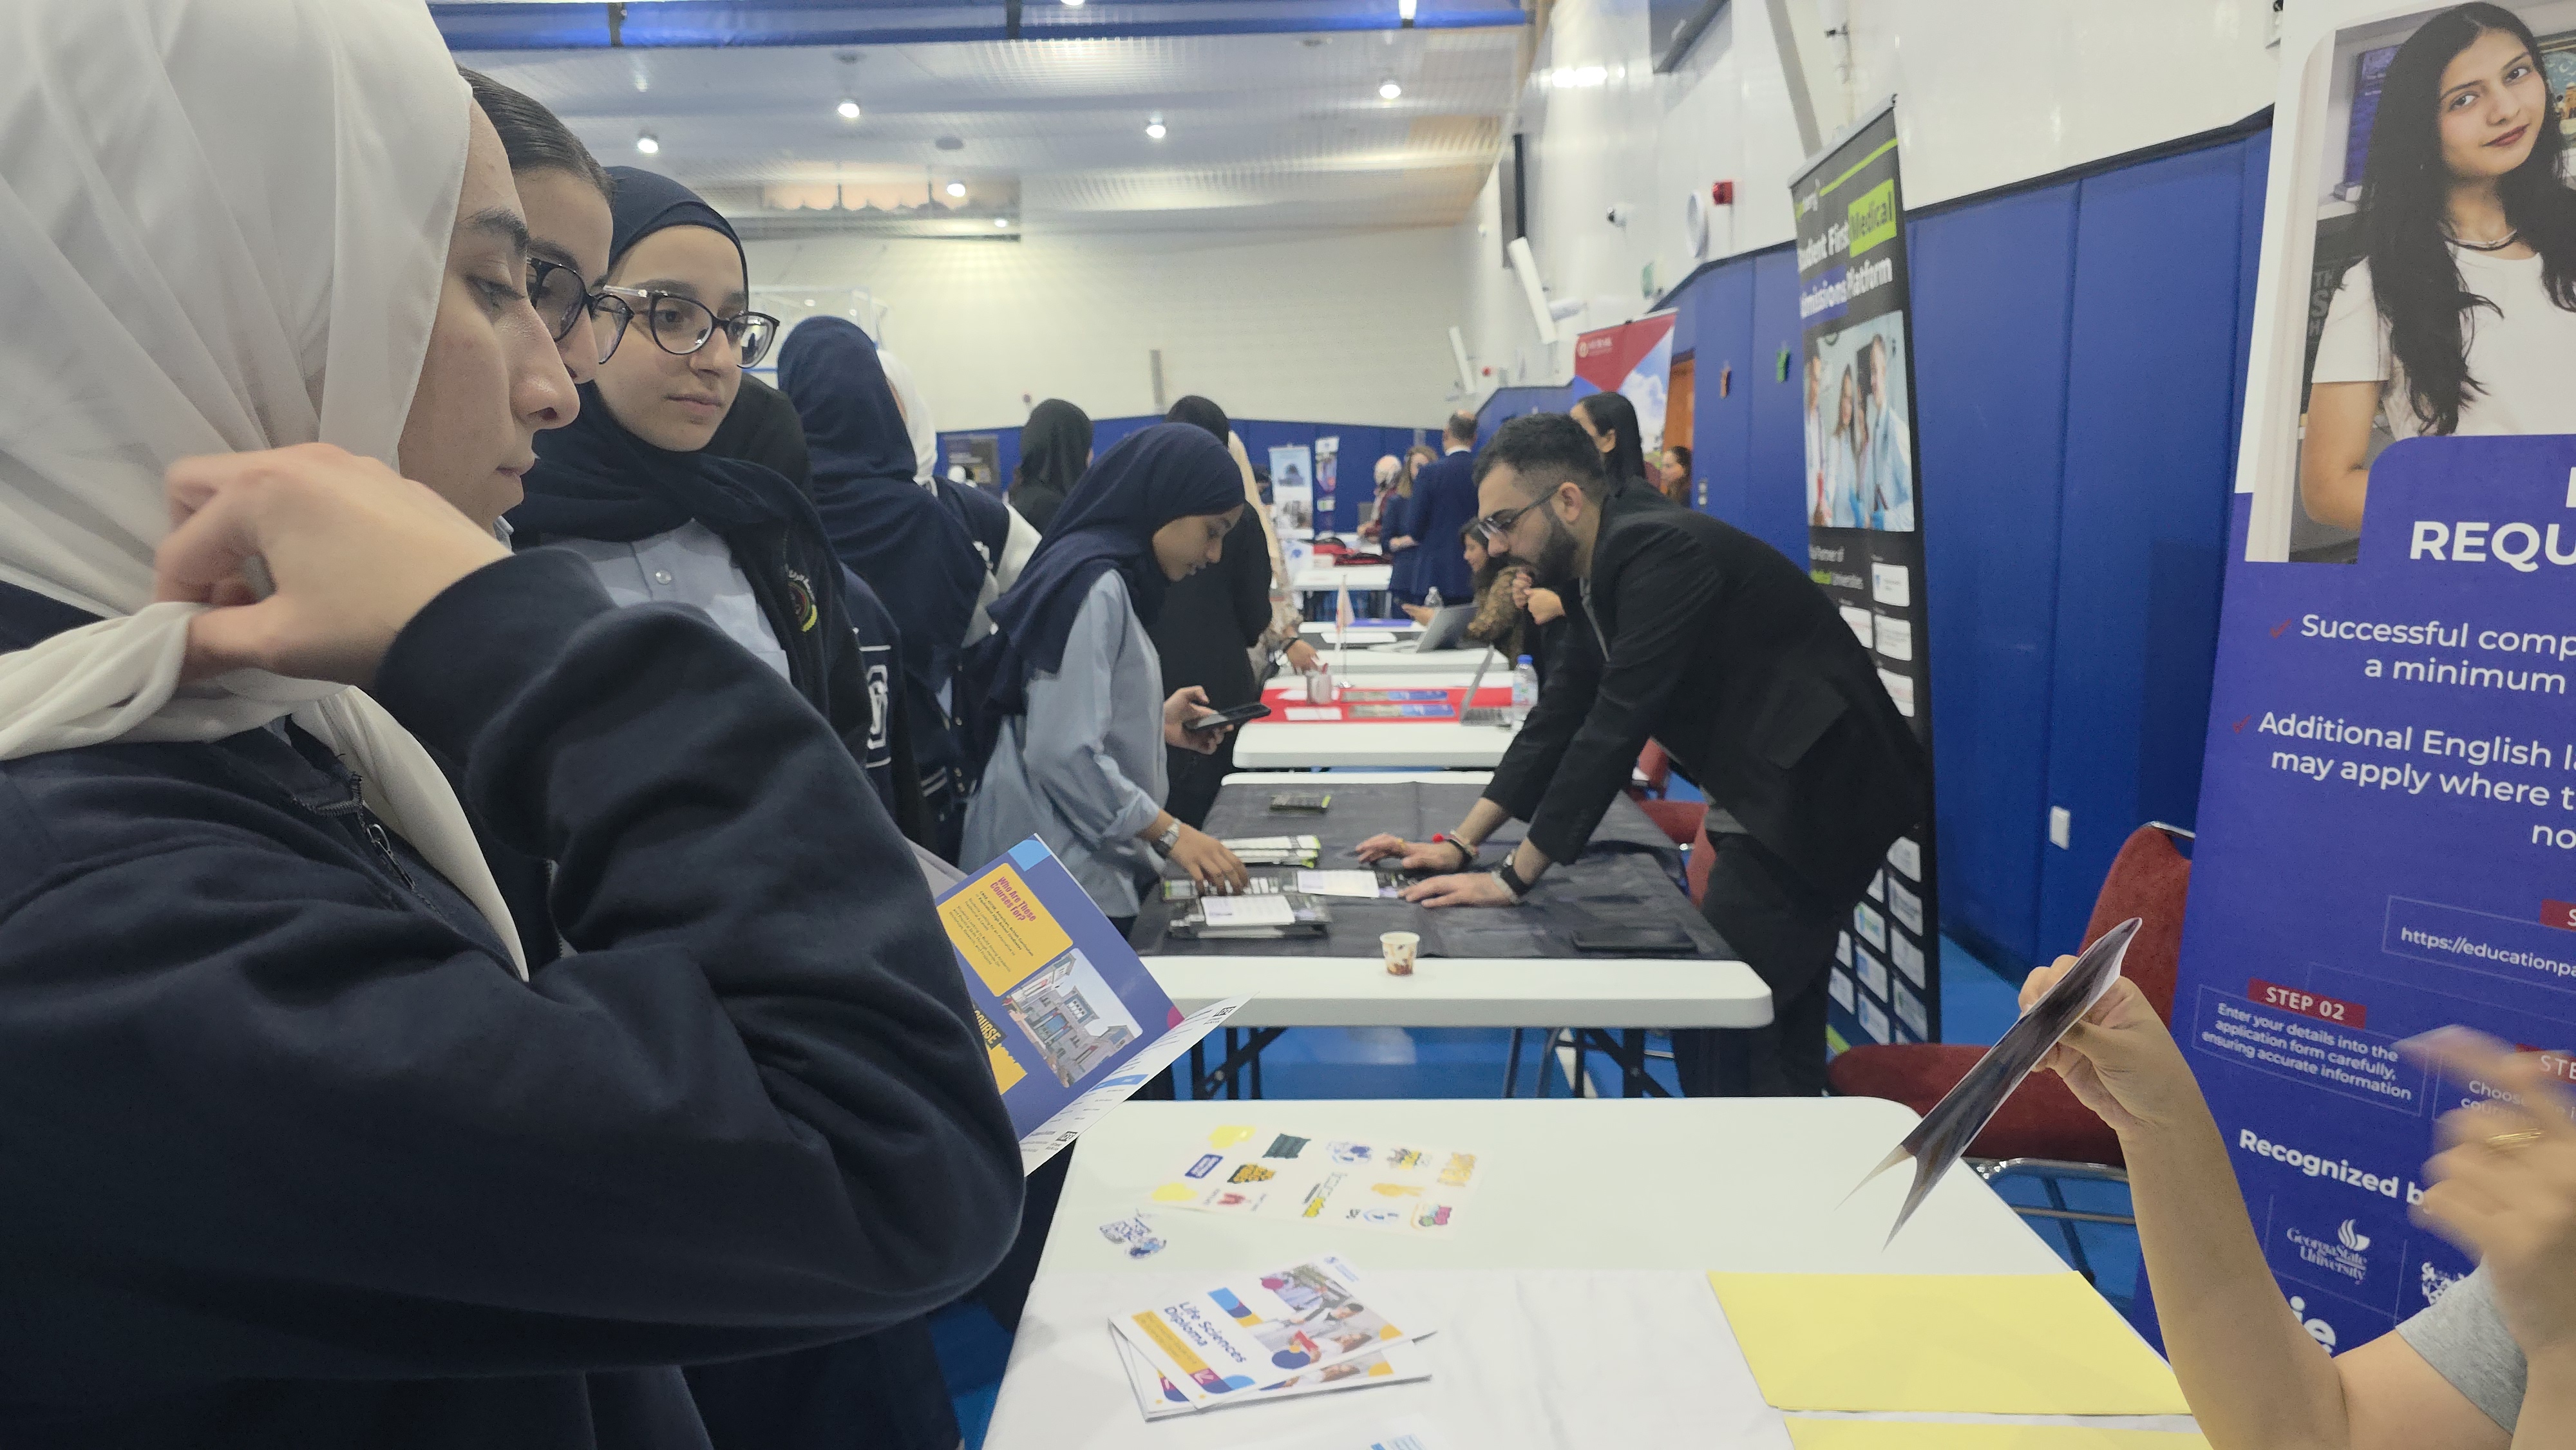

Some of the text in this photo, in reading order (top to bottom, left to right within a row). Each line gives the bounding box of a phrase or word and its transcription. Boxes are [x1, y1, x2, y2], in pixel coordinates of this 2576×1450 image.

[1850, 189, 1893, 243] Medical
[1846, 257, 1893, 300] Platform
[2300, 614, 2576, 661] Successful comp
[2364, 657, 2566, 695] a minimum
[2258, 711, 2413, 752] Additional
[2423, 730, 2552, 768] English
[2271, 751, 2334, 781] may
[2340, 760, 2431, 796] apply
[2438, 772, 2550, 806] where
[990, 881, 1014, 909] Courses
[1010, 905, 1026, 921] For?
[998, 876, 1012, 892] Who
[1009, 890, 1021, 903] Are
[1018, 900, 1036, 921] These
[2266, 986, 2345, 1021] STEP 02
[2215, 1019, 2397, 1080] application form carefully,
[2217, 1002, 2399, 1062] Enter your details into the
[2202, 1031, 2412, 1100] ensuring accurate information
[2468, 1080, 2524, 1106] Choos
[2239, 1129, 2400, 1199] Recognized
[2299, 1245, 2368, 1286] University
[1164, 1306, 1208, 1346] Diploma
[1179, 1301, 1200, 1321] Life
[1198, 1321, 1247, 1363] Sciences
